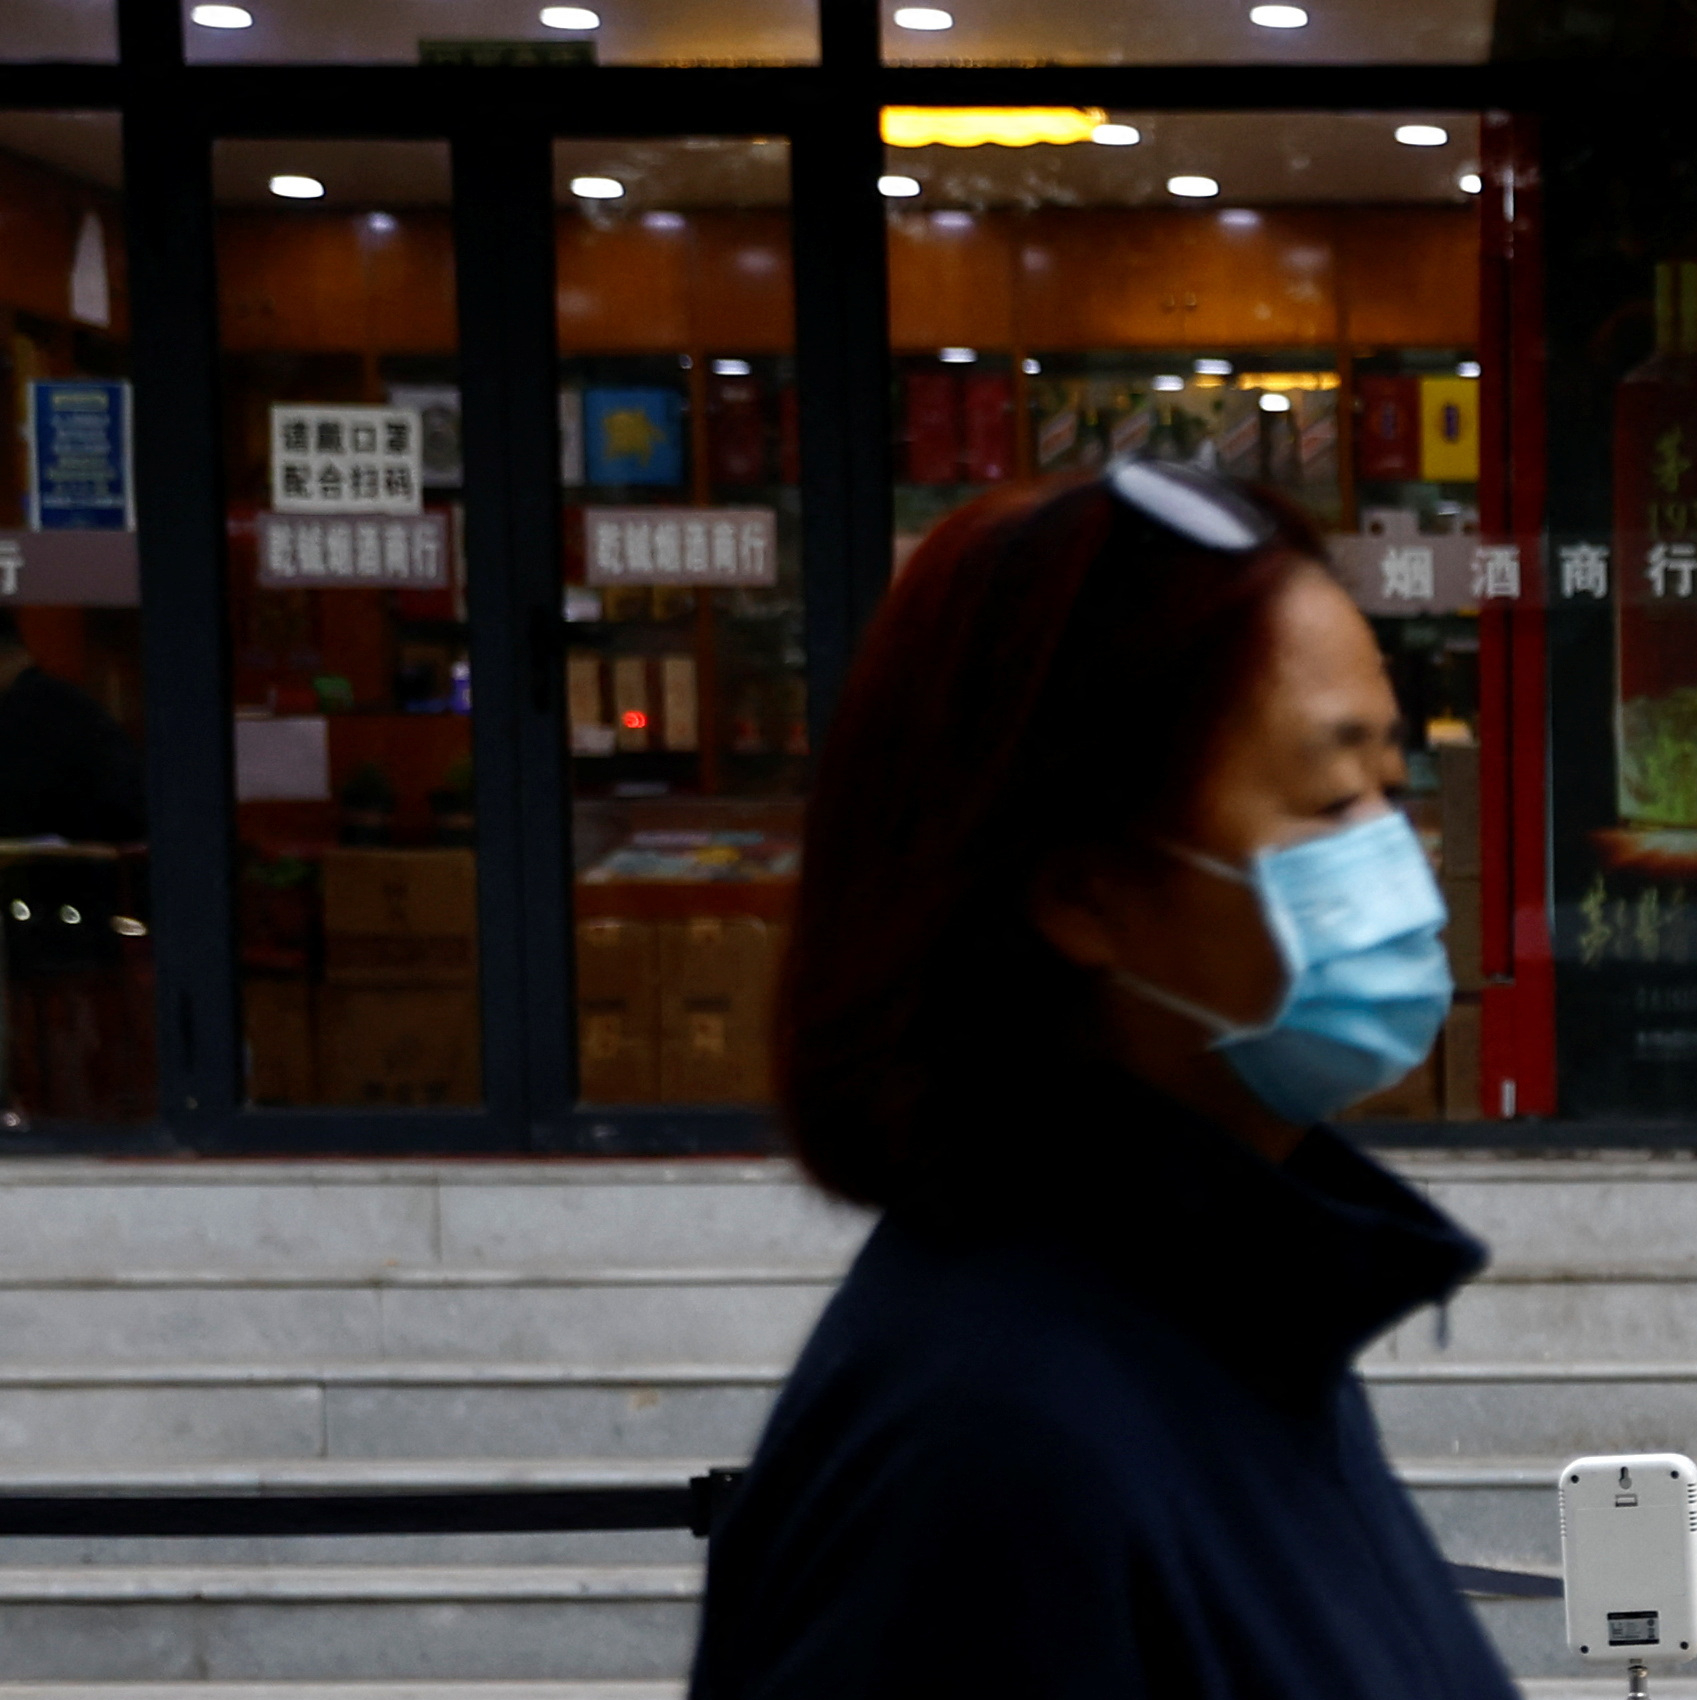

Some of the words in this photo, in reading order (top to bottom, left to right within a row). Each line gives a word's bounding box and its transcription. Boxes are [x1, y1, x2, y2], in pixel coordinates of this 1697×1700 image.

[282, 419, 408, 452] 请戴口罩
[282, 461, 412, 498] 配合扫码
